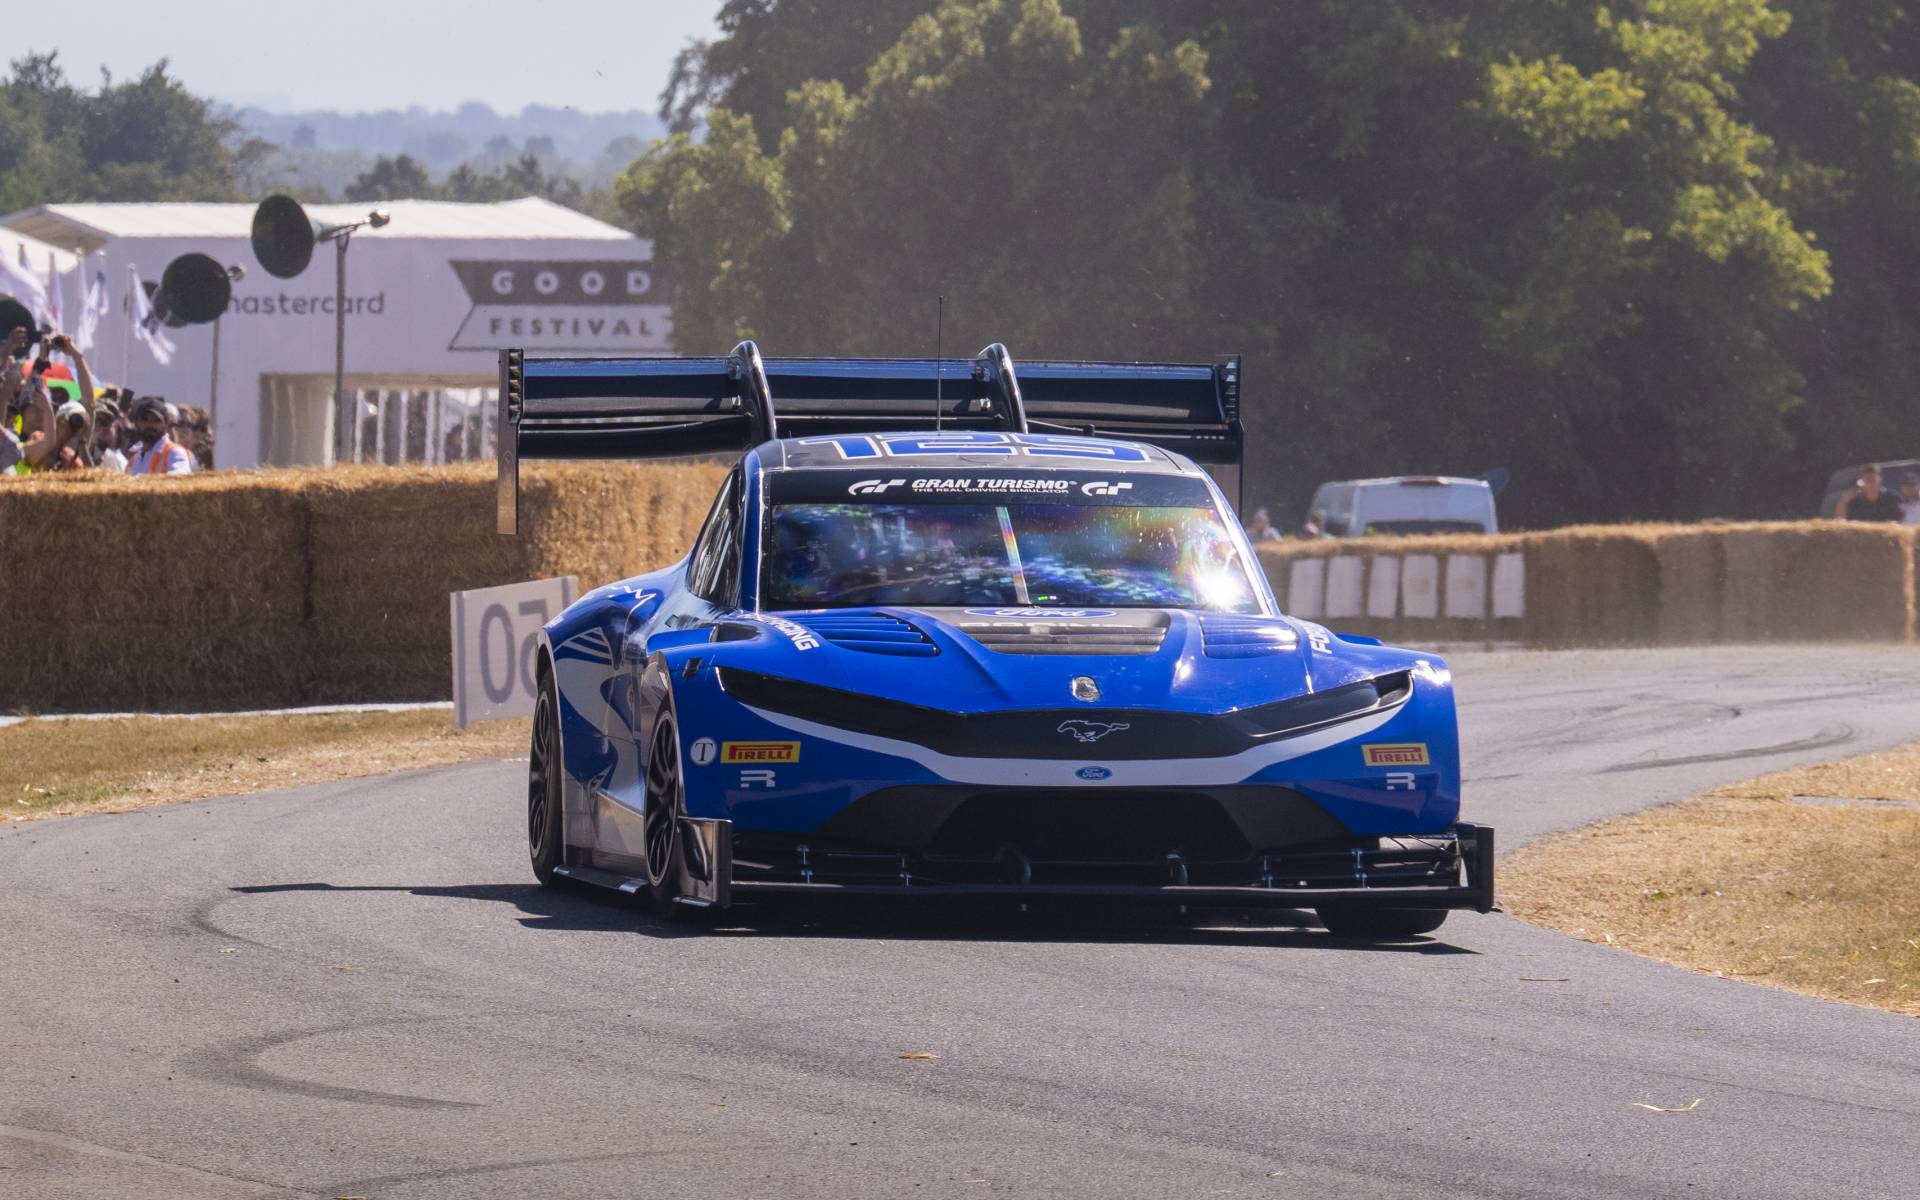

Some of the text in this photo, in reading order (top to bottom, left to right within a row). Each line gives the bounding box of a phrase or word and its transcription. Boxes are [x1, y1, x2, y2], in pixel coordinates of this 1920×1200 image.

[490, 318, 652, 336] FESTIVAL
[911, 479, 971, 488] GRAN
[995, 607, 1087, 617] Ford
[728, 744, 794, 760] PIRELLI
[1369, 746, 1424, 763] PIRELLI
